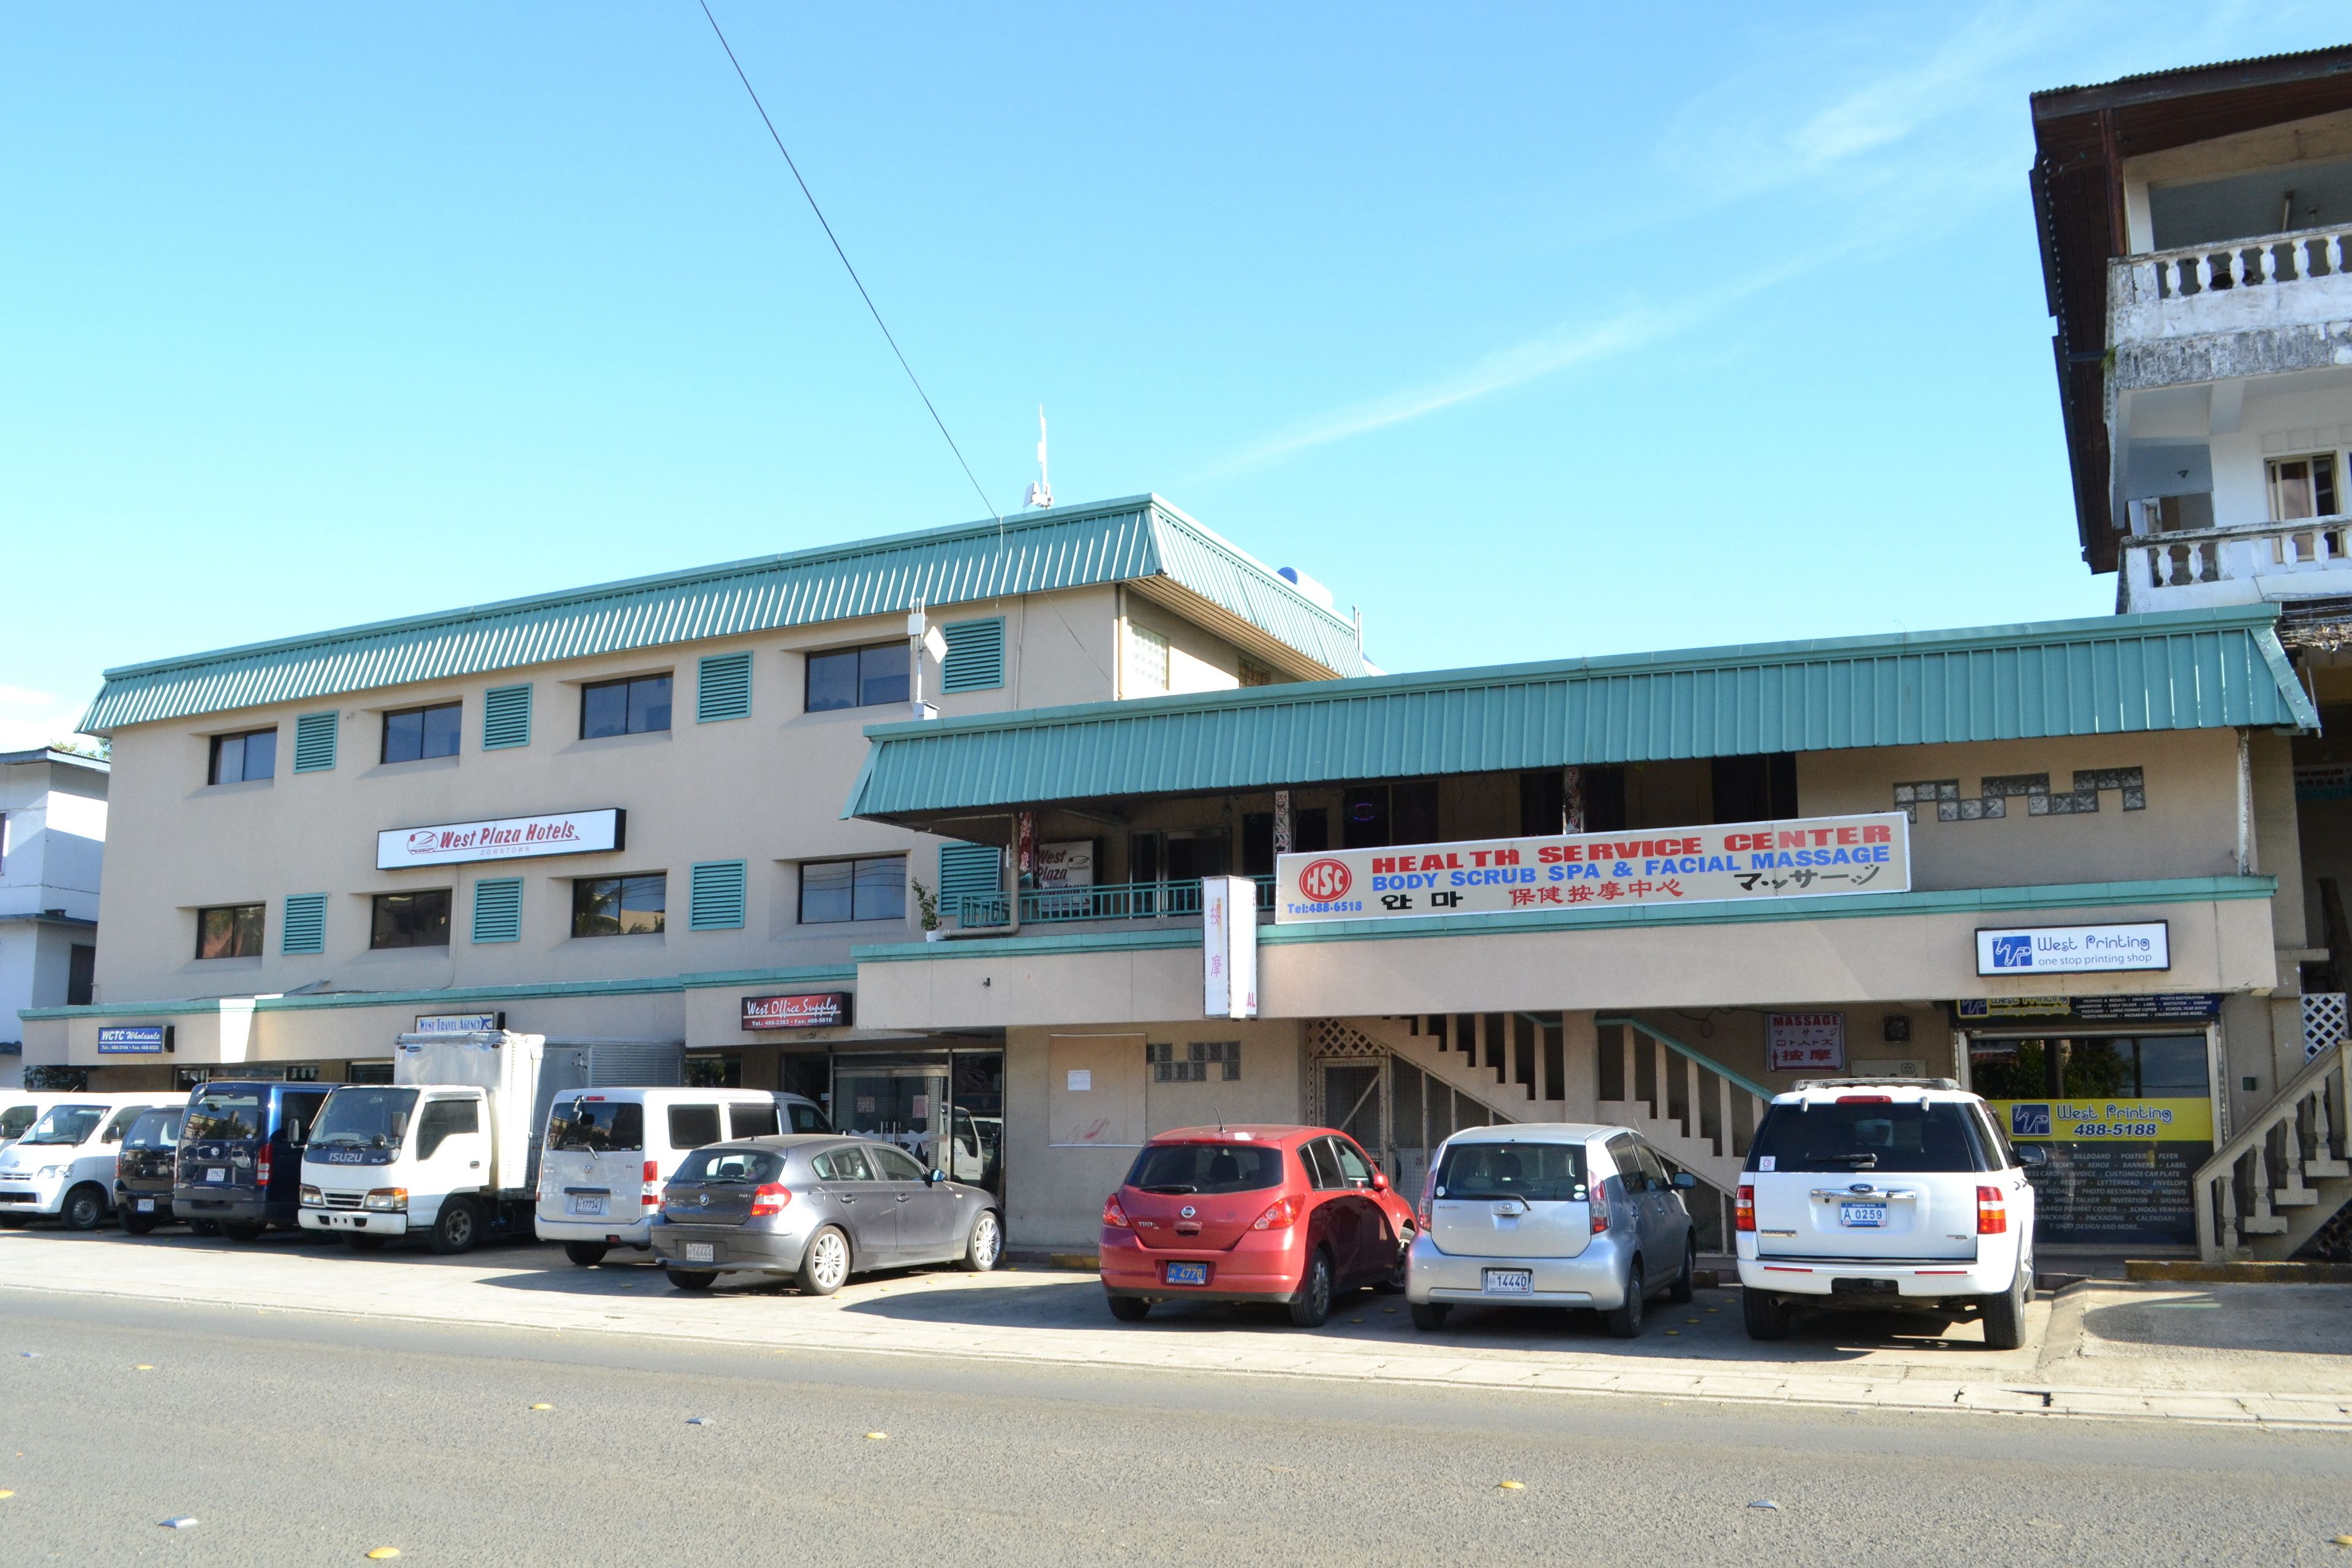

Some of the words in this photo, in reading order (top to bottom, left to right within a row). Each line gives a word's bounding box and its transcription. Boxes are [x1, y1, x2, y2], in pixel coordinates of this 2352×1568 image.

[440, 831, 477, 848] West
[480, 827, 521, 845] Plaza
[526, 821, 575, 841] Hotels
[480, 846, 530, 856] DOWNTOWN
[1372, 850, 1520, 873] HEALTH
[1539, 837, 1702, 863] SERVICE
[1724, 825, 1891, 851] CENTER
[1373, 873, 1438, 891] BODY
[1450, 868, 1536, 886] SCRUB
[1548, 864, 1600, 881] SPA
[1613, 861, 1633, 877] &
[1646, 855, 1741, 876] FACIAL
[1751, 846, 1890, 870] MASSAGE
[1307, 865, 1344, 896] HSC
[1734, 864, 1880, 891] マッサージ
[1509, 878, 1684, 906] 保健按摩中心
[2038, 937, 2078, 951] West
[2086, 935, 2150, 951] Printing
[2060, 956, 2082, 966] stop
[2084, 954, 2124, 966] printing
[2127, 953, 2152, 963] shop
[747, 1001, 768, 1015] West
[771, 1000, 799, 1018] Office
[803, 997, 837, 1017] Supply
[1773, 1016, 1839, 1026] MASSAGE
[102, 1030, 124, 1041] WCTC
[126, 1031, 160, 1040] Wholesale
[1775, 1028, 1837, 1037] マッサージ
[1782, 1049, 1832, 1061] 按摩
[858, 1101, 875, 1112] OPEN
[2057, 1105, 2098, 1120] West
[2106, 1104, 2173, 1123] Printing
[2073, 1123, 2156, 1136] 488-5188
[329, 1153, 363, 1162] ISUZU
[1844, 1207, 1852, 1220] A
[1855, 1210, 1882, 1219] 0259
[1180, 1268, 1203, 1279] 4778
[1497, 1276, 1527, 1287] 14440
